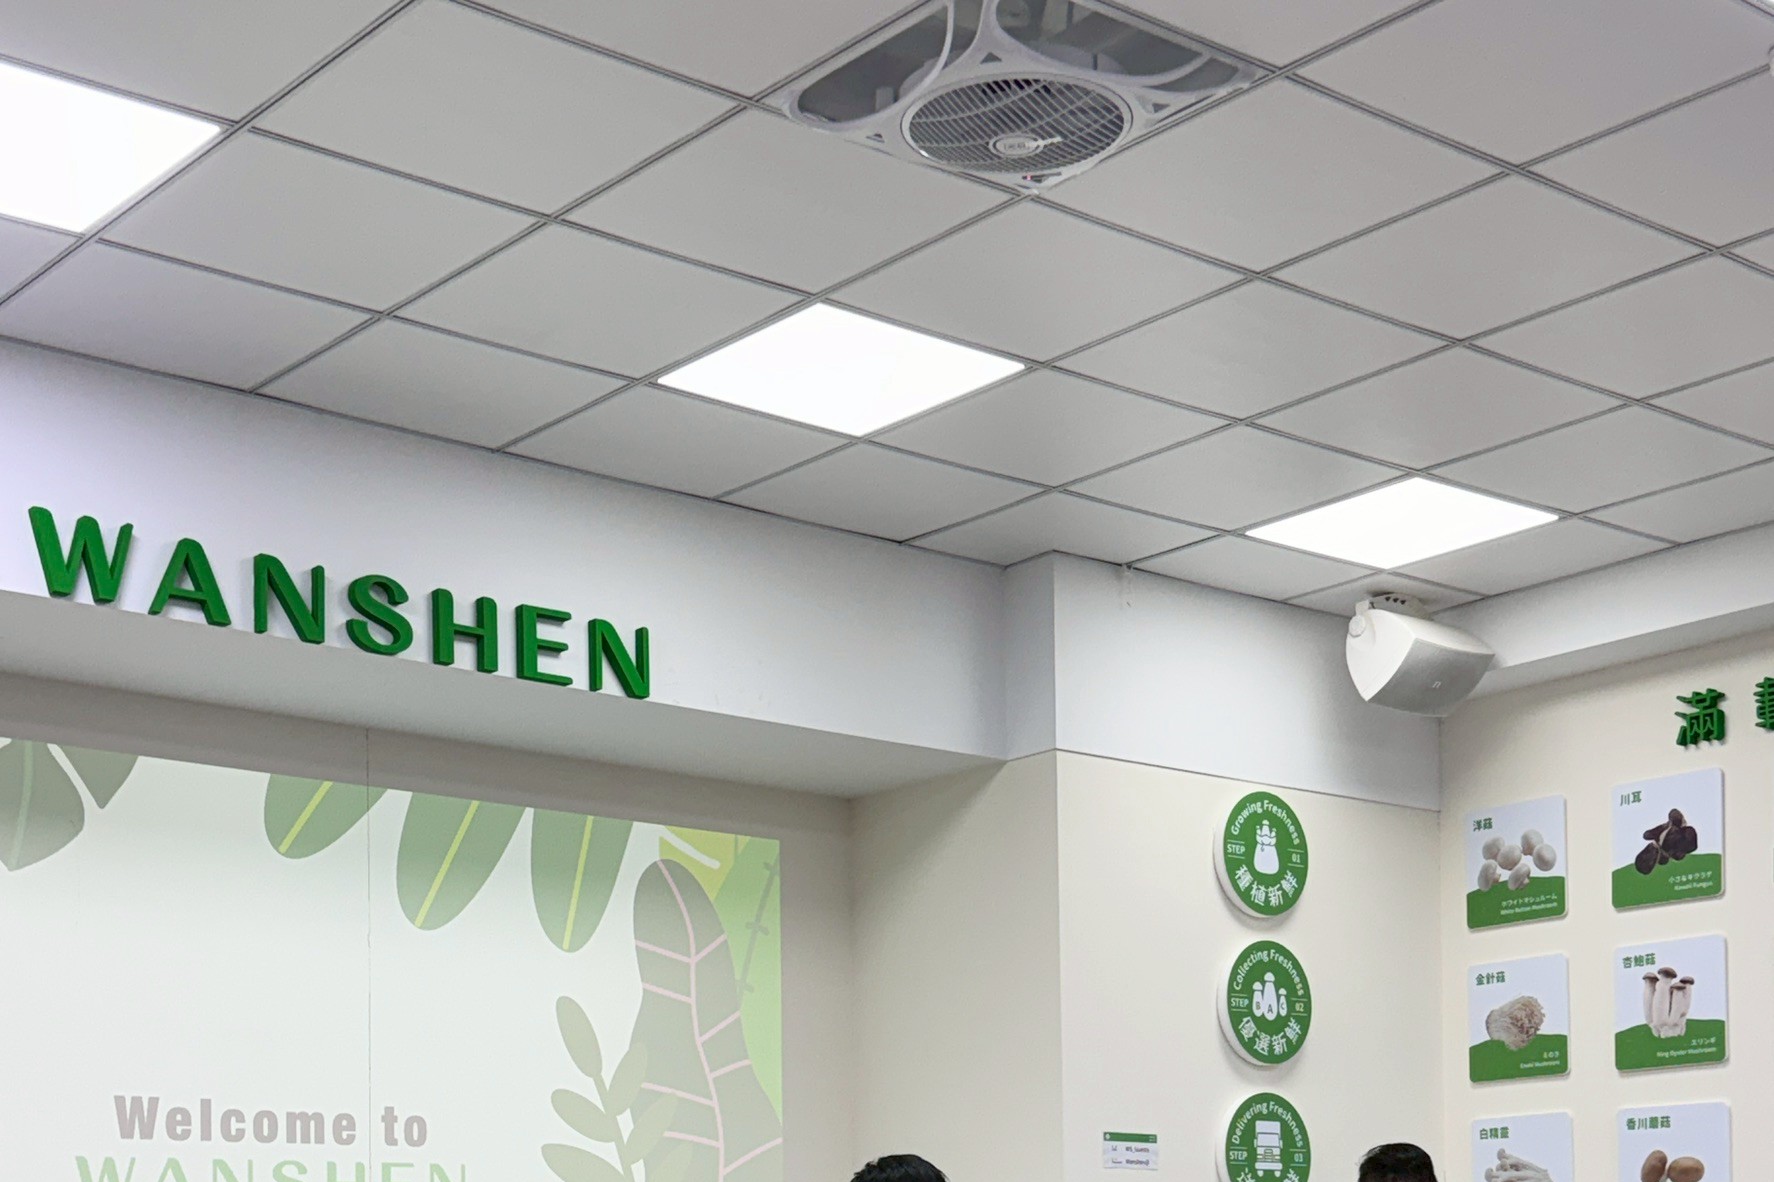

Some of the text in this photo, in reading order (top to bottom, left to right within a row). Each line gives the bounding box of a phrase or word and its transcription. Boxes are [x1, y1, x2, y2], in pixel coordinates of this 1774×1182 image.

[28, 505, 650, 700] WANSHEN
[1620, 791, 1642, 806] 川耳
[1231, 800, 1300, 845] Growing Freshness
[1473, 818, 1493, 831] 洋菇
[1227, 844, 1301, 863] STEP 01
[1235, 864, 1299, 907] 種植新鮮
[1622, 953, 1657, 969] 杏鮑菇
[1233, 949, 1304, 996] Collecting Freshness
[1475, 971, 1506, 986] 金針菇
[1231, 998, 1249, 1008] STEP
[1256, 1001, 1262, 1011] B
[1267, 1004, 1274, 1014] A
[1280, 1001, 1286, 1010] C
[1295, 1003, 1305, 1012] 02
[1238, 1017, 1302, 1056] 優選新鮮
[113, 1095, 428, 1147] Welcome to
[1231, 1101, 1304, 1147] Delivering Freshness
[1626, 1116, 1671, 1131] 香川蘑菇
[1229, 1151, 1248, 1160] STEP
